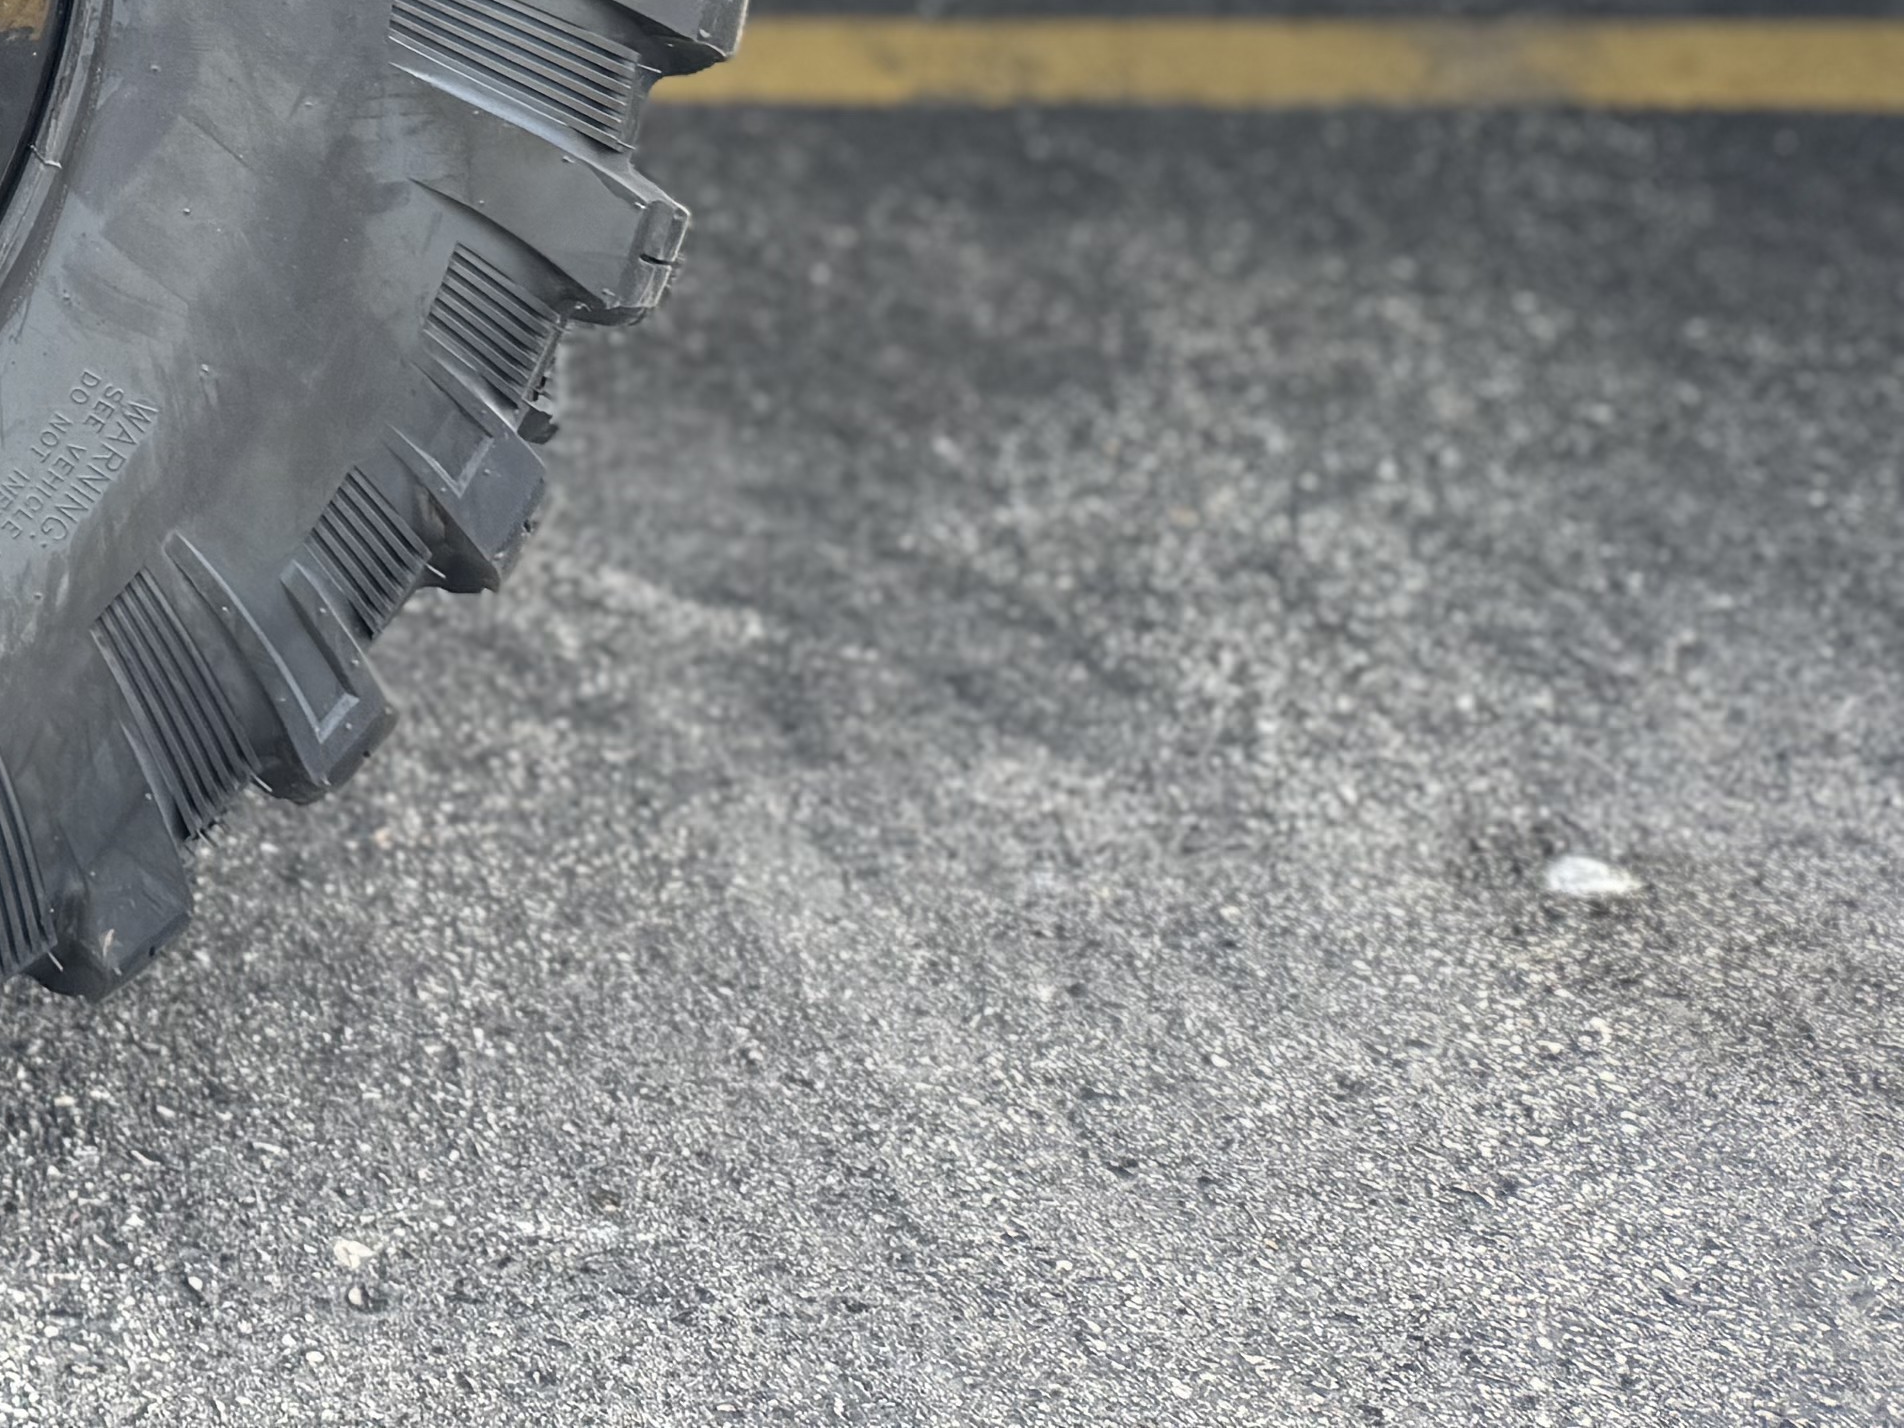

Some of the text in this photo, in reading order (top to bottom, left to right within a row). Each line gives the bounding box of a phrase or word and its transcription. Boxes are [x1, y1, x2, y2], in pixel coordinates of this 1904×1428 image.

[69, 368, 102, 406] DO
[82, 384, 125, 434] SEE
[30, 411, 73, 464] NOT
[1, 444, 88, 540] VEHICLE
